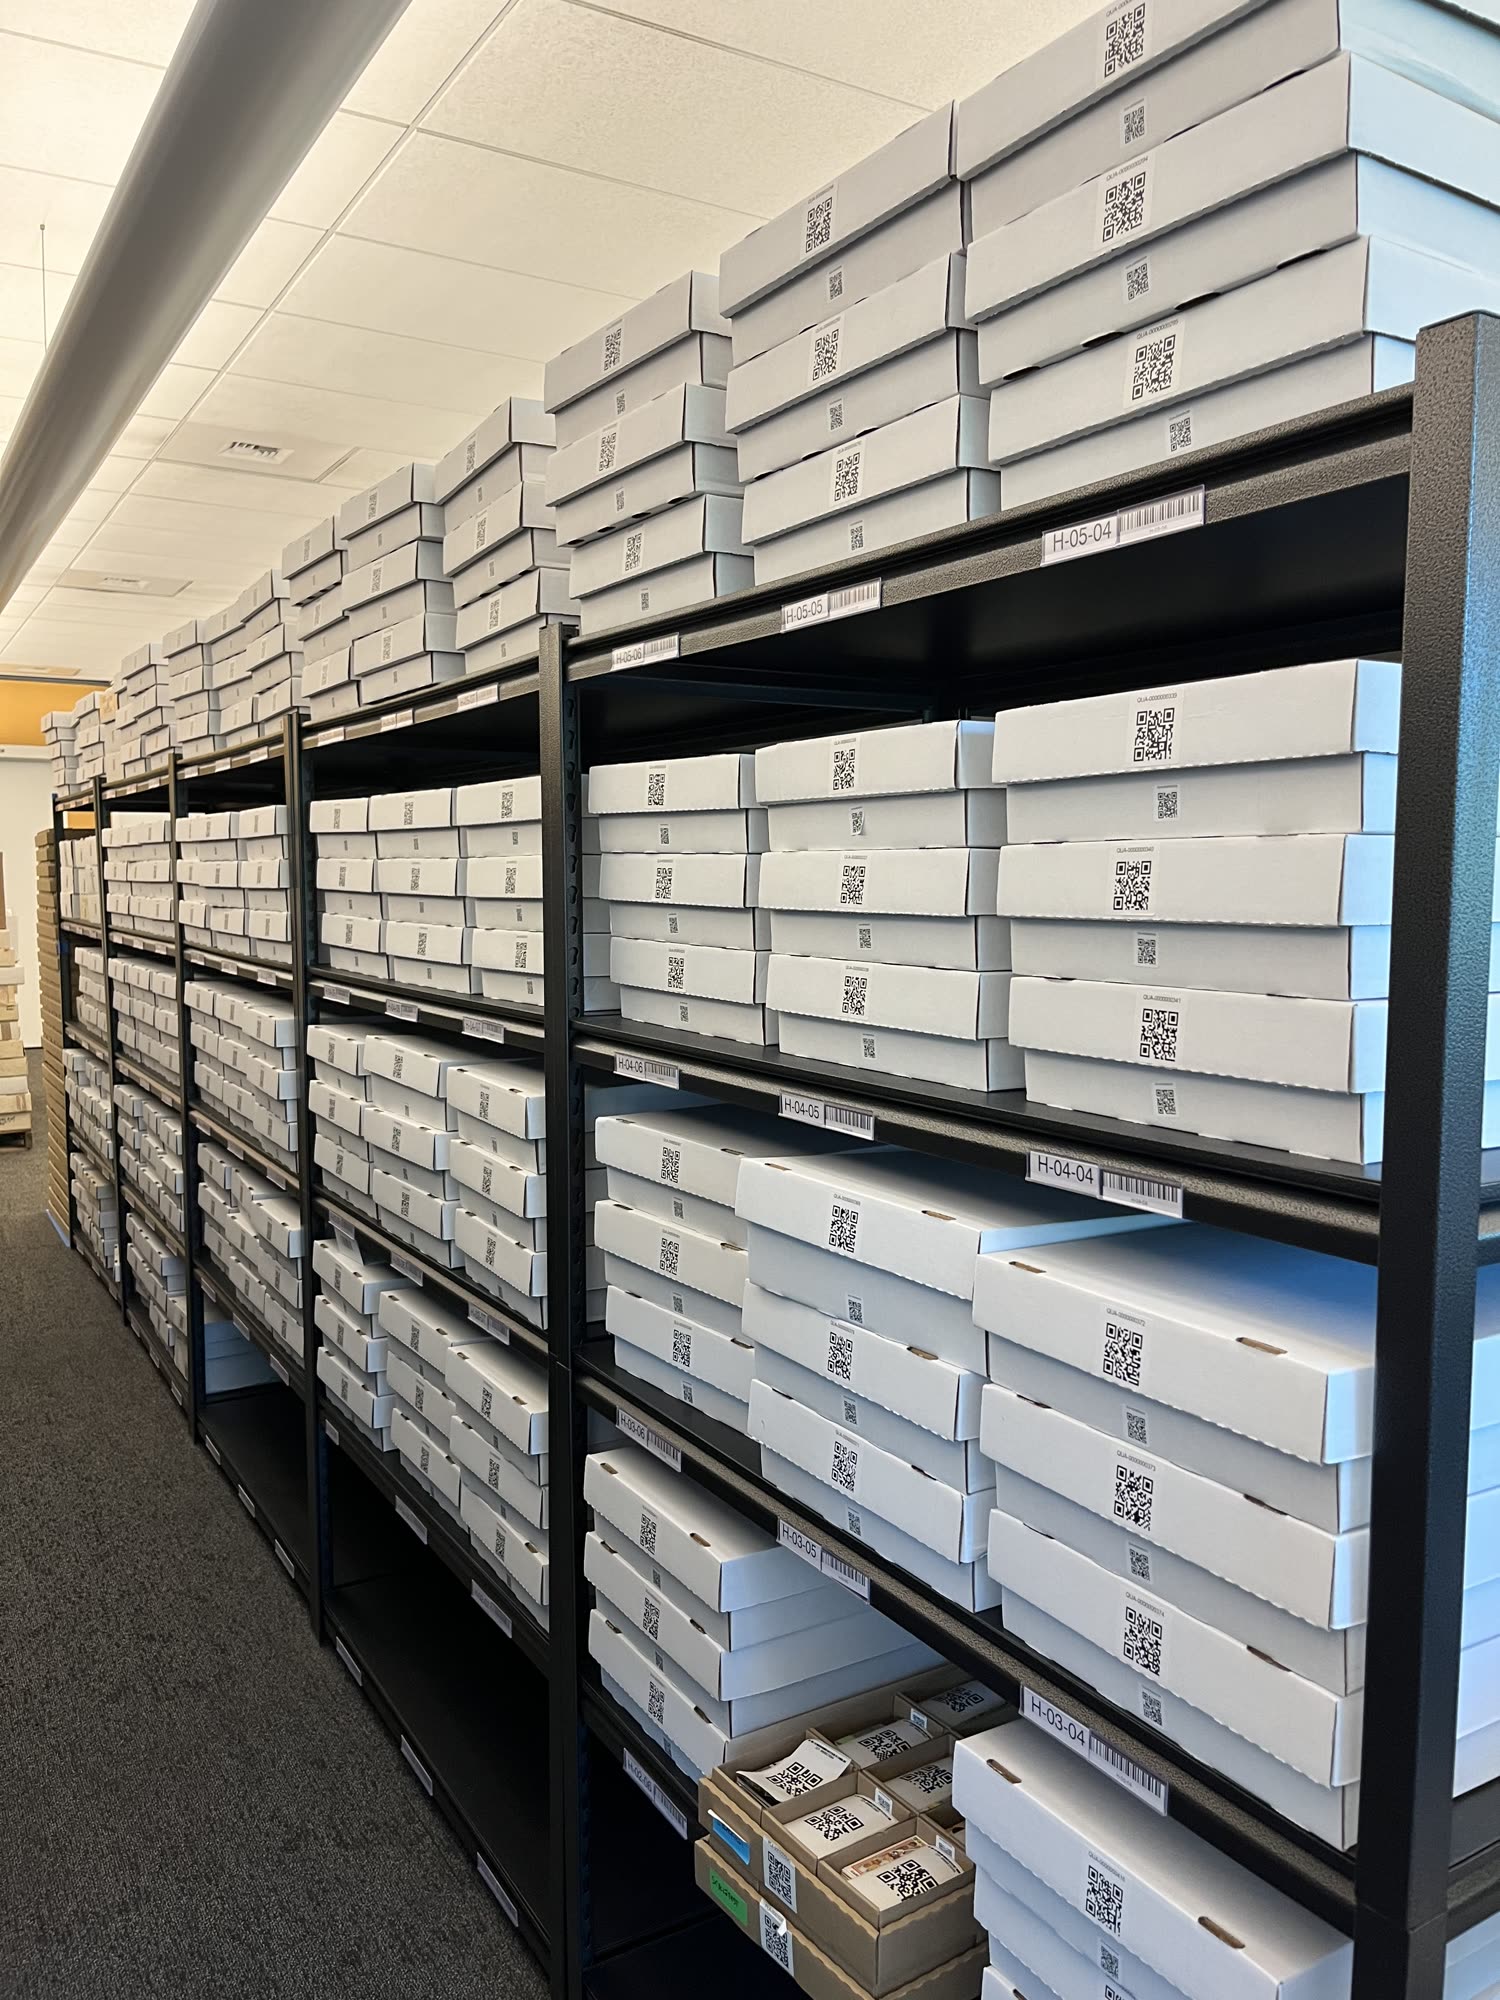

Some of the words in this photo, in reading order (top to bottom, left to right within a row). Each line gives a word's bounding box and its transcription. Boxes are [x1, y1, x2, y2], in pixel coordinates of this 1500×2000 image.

[1053, 521, 1111, 552] H-05-04
[786, 600, 822, 624] H-05-05
[616, 648, 641, 664] H-05-06
[619, 1057, 643, 1073] H-04-06
[784, 1098, 819, 1119] H-04-05
[1038, 1155, 1093, 1184] H-04-04
[620, 1413, 645, 1439] H-03-06
[782, 1523, 817, 1558] H-03-05
[1031, 1696, 1085, 1746] H-03-04
